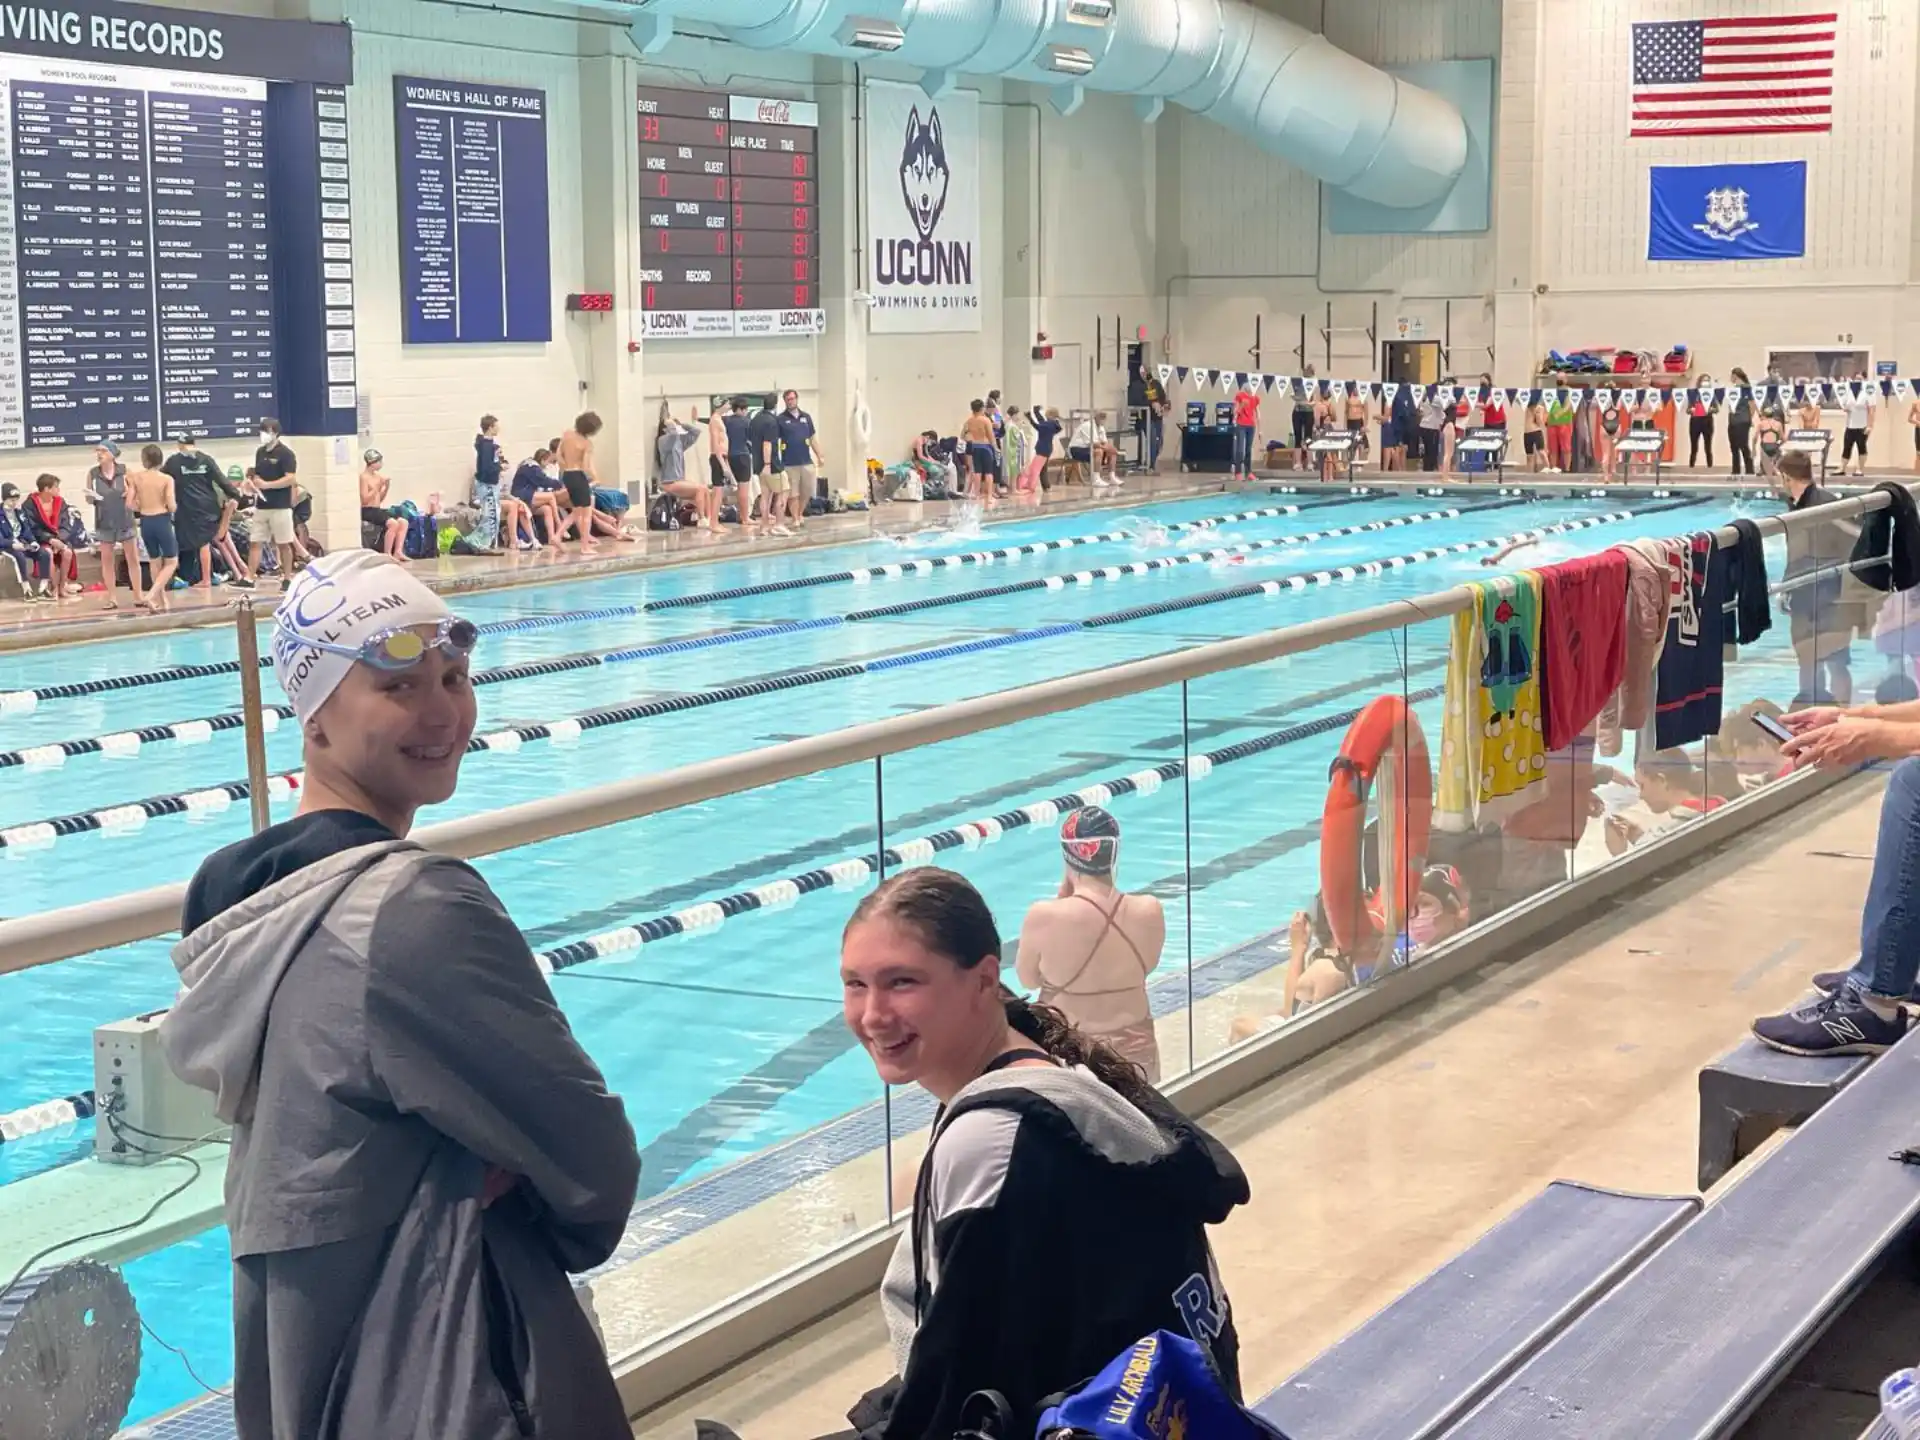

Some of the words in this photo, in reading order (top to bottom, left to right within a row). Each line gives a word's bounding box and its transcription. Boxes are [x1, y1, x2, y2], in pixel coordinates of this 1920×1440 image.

[91, 16, 224, 61] RECORDS
[71, 72, 86, 80] POOL
[88, 74, 117, 82] RECORDS
[406, 86, 460, 103] WOMEN'S
[465, 92, 491, 106] HALL
[494, 95, 508, 107] OF
[512, 96, 541, 110] FAME
[638, 100, 657, 112] EVENT
[709, 107, 724, 119] HEAT
[644, 118, 659, 140] 33
[716, 124, 724, 144] 4
[730, 136, 746, 148] LANE
[748, 138, 767, 149] PLACE
[781, 140, 794, 152] TIME
[678, 148, 692, 159] MEN
[647, 158, 665, 169] HOME
[704, 161, 724, 173] GUEST
[676, 203, 699, 214] WOMEN
[650, 214, 669, 226] HOME
[706, 217, 725, 228] GUEST
[876, 239, 971, 285] UCONN
[686, 270, 711, 282] RECORD
[932, 297, 937, 308] &
[942, 296, 977, 308] DIVING
[651, 313, 686, 328] UCONN
[780, 312, 812, 326] UCONN
[338, 593, 408, 628] TEAM
[1822, 1016, 1865, 1044] N
[1172, 1272, 1227, 1346] R
[1120, 1336, 1158, 1398] ARCHIBALD
[1105, 1392, 1136, 1425] LILY
